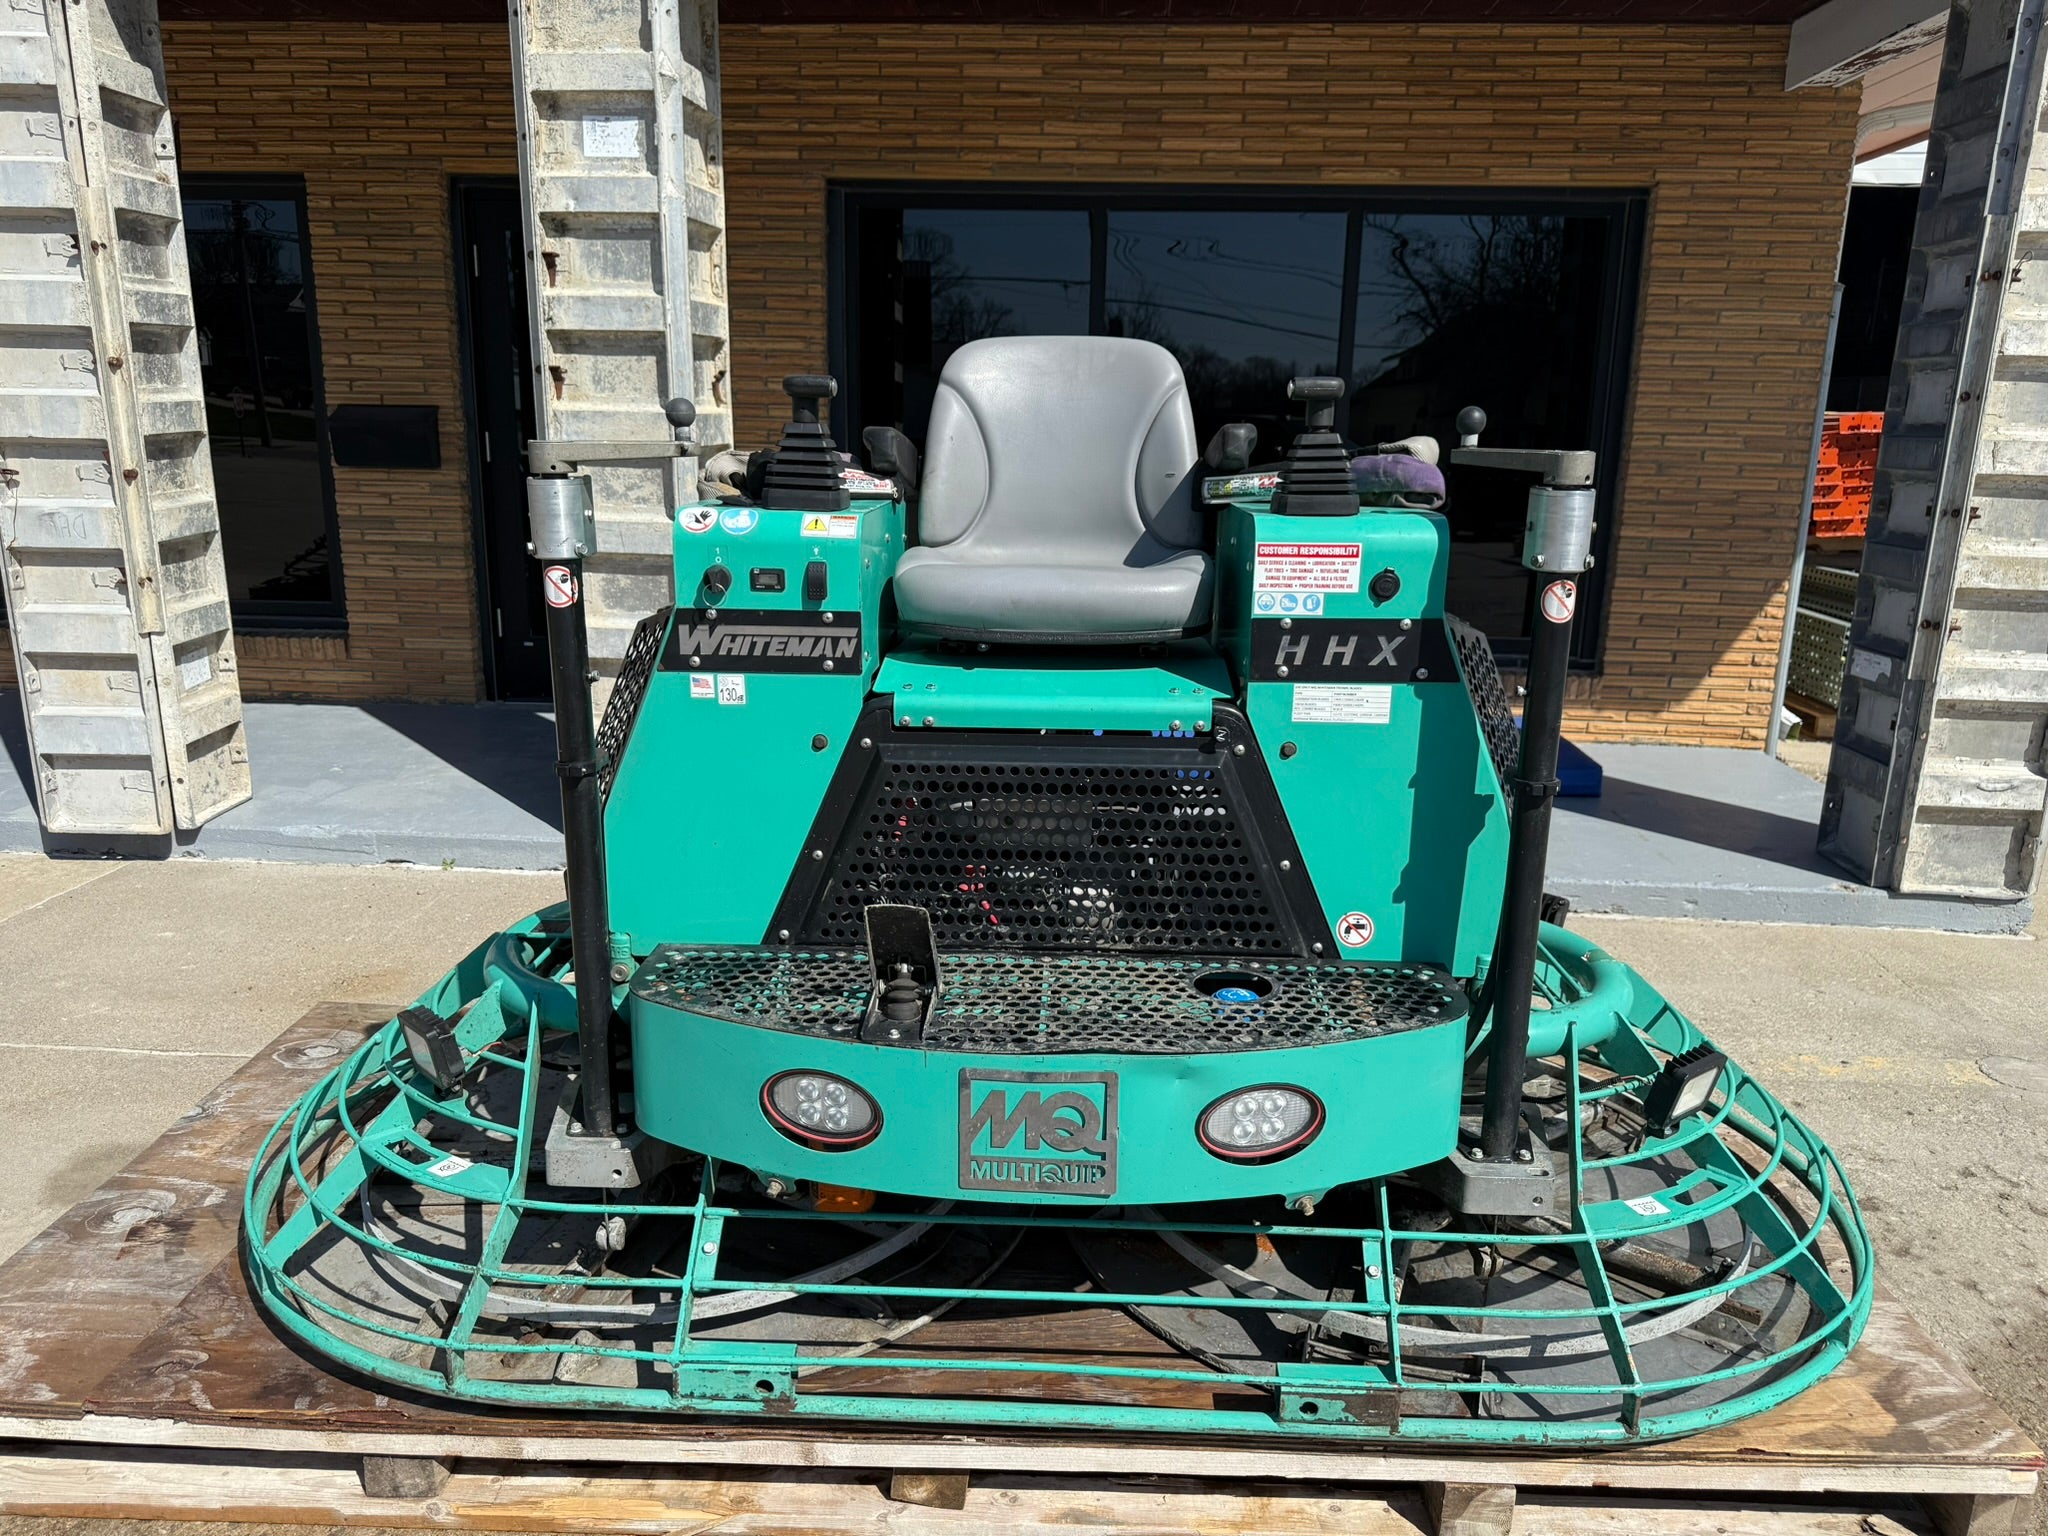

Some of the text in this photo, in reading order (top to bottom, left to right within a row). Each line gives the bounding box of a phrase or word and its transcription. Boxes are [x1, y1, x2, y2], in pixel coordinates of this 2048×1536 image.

[1259, 546, 1358, 556] CUSTOMER RESPONSIBILITY
[678, 624, 858, 658] WHITEMAN
[970, 1090, 1105, 1153] MQ
[970, 1160, 1106, 1185] MULTIQUIP
